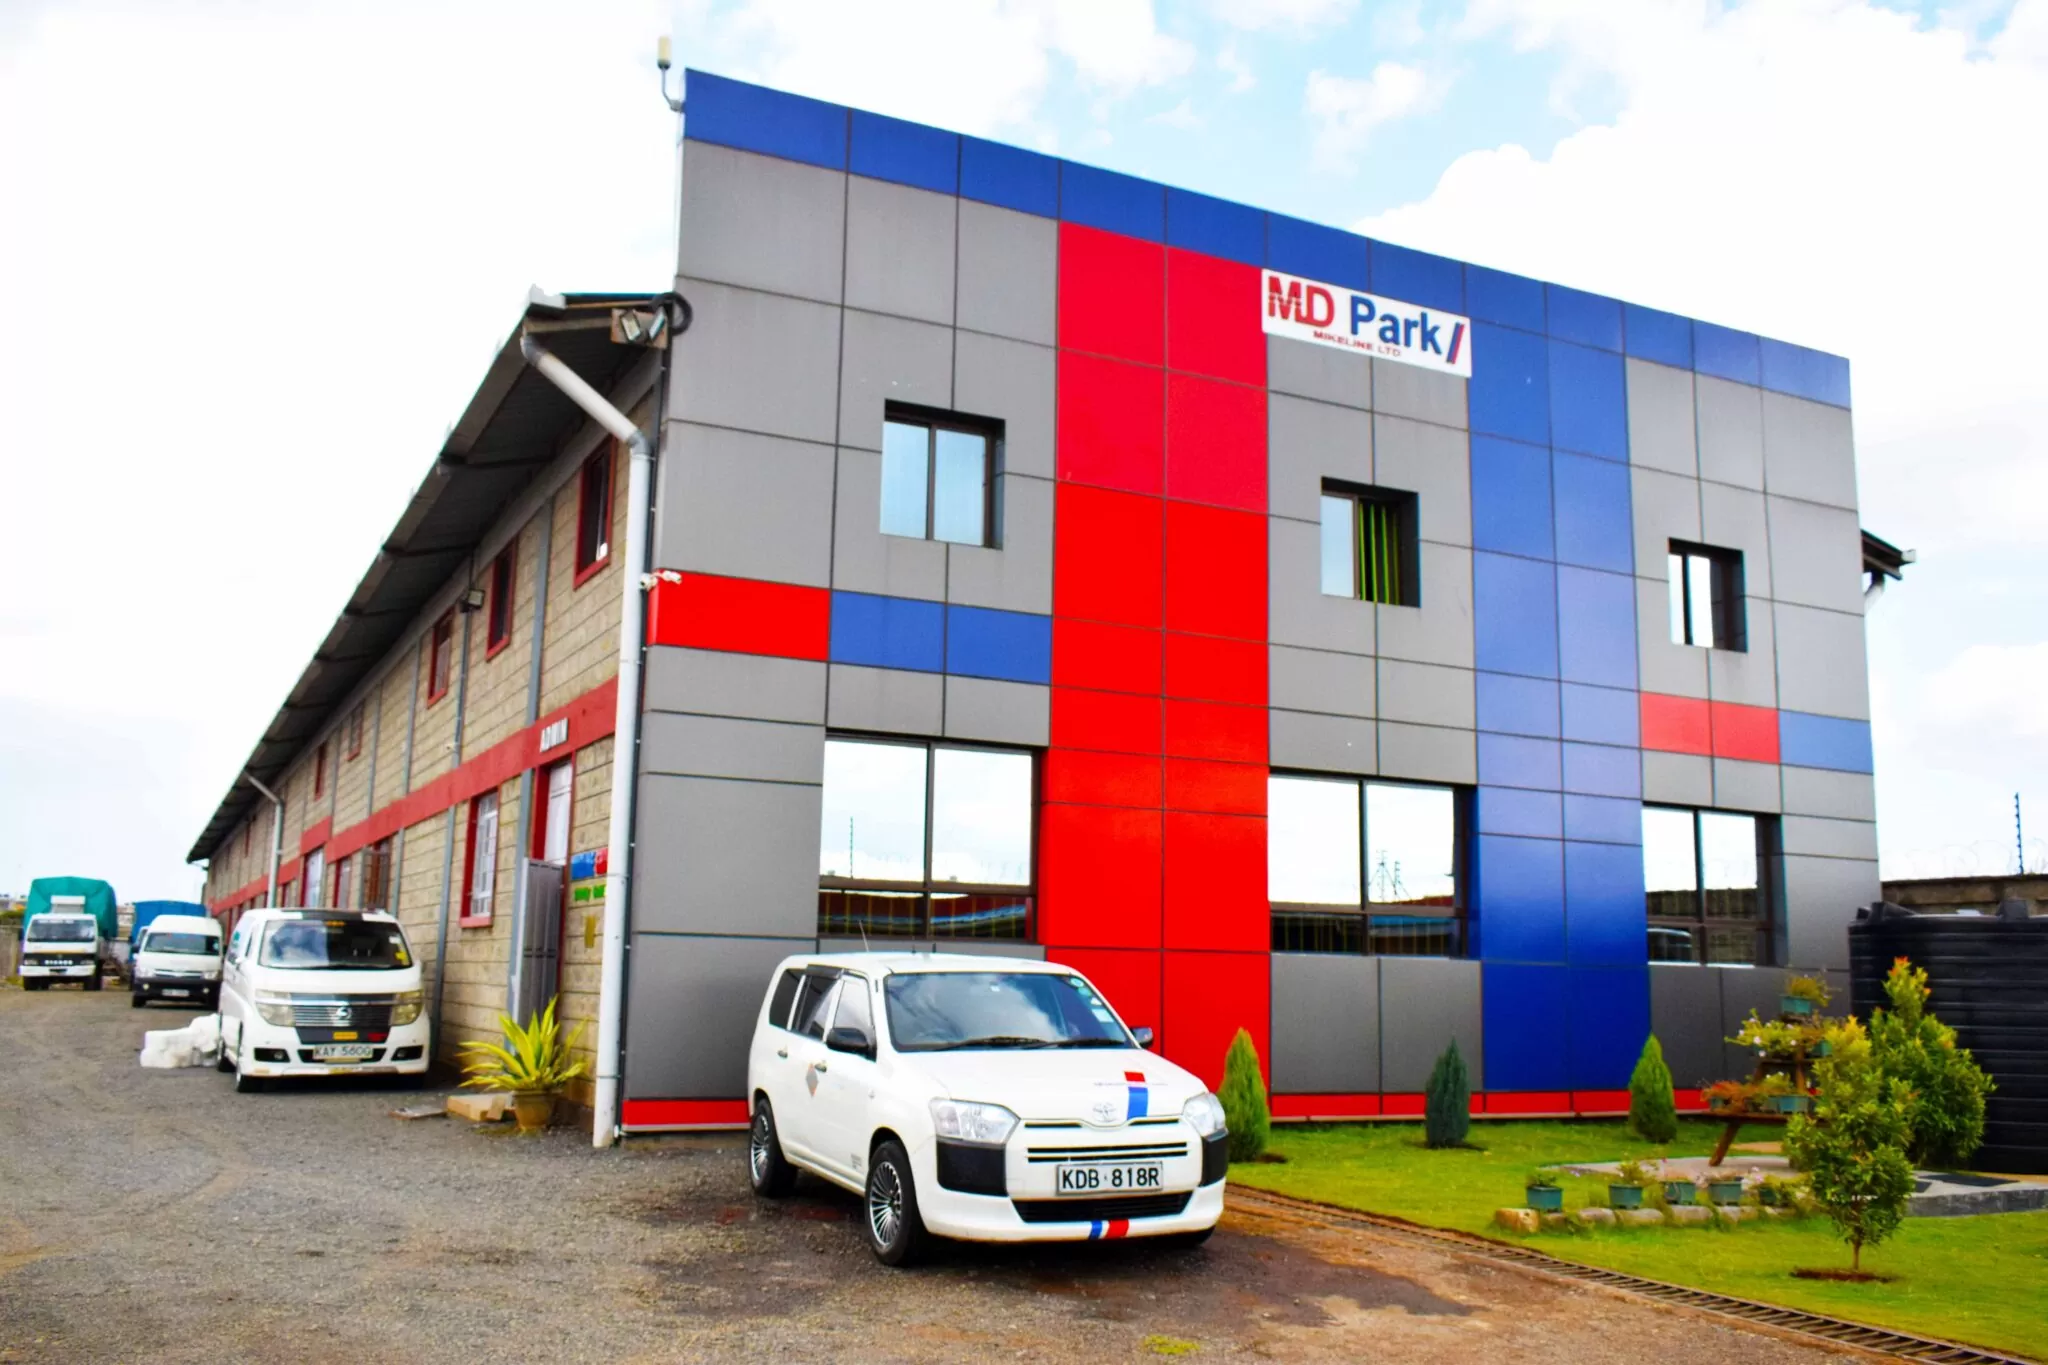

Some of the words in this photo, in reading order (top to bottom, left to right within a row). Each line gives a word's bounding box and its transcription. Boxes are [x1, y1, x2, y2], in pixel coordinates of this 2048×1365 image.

[1268, 275, 1335, 328] MD
[1350, 294, 1442, 356] Park
[1312, 329, 1374, 350] MIKELINE
[1377, 343, 1401, 357] LTD
[1062, 1168, 1100, 1189] KDB
[1111, 1167, 1160, 1188] 818R
